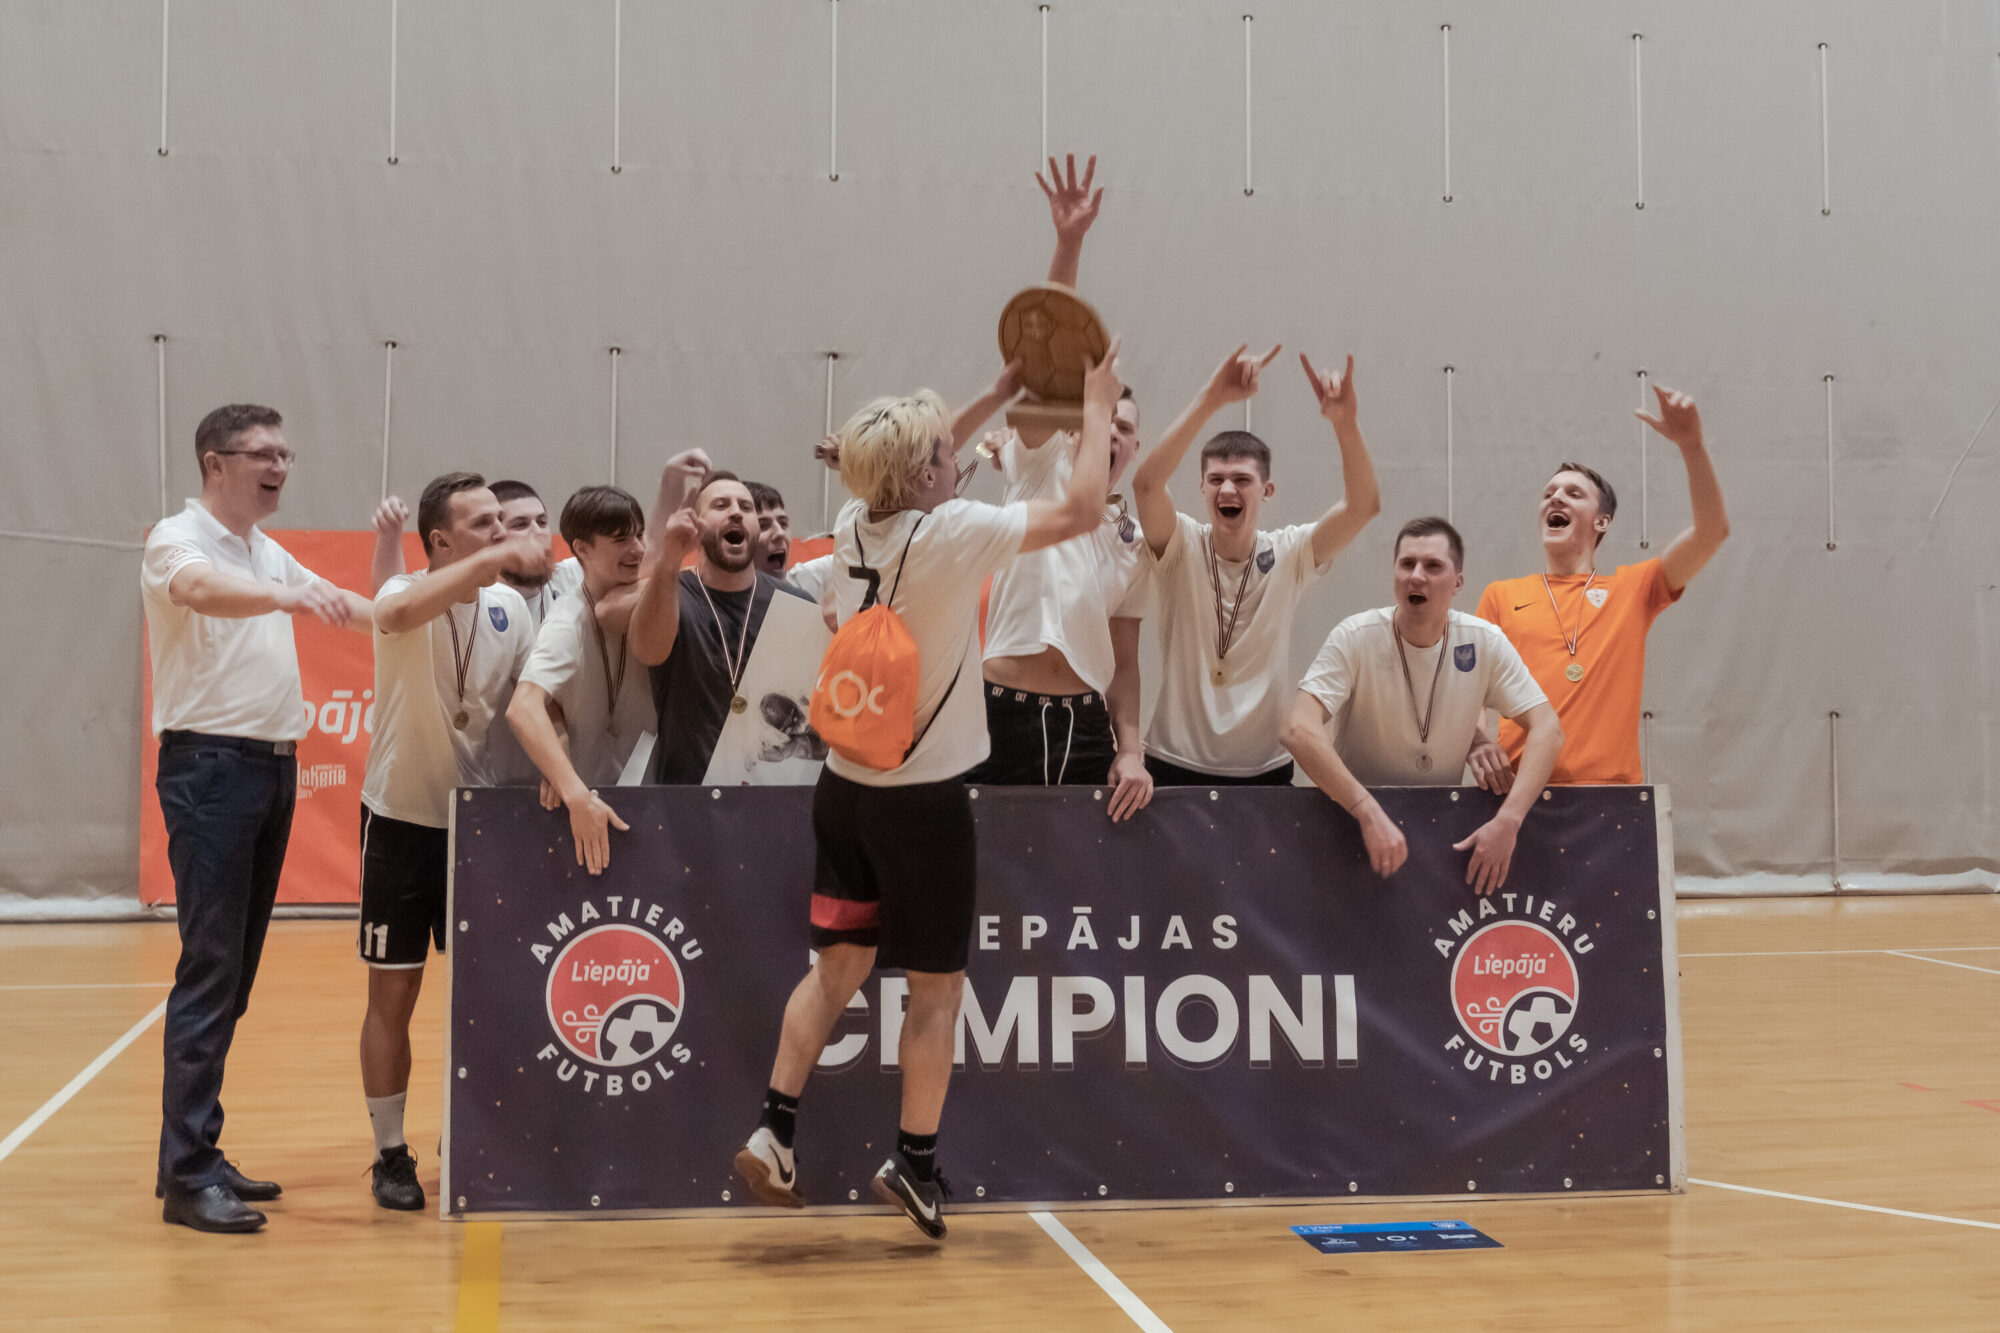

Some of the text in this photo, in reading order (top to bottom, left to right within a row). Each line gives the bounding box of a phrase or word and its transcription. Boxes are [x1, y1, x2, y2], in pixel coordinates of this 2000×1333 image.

[848, 566, 881, 614] 7
[364, 921, 389, 959] 11
[530, 896, 703, 965] AMATIERU
[979, 906, 1239, 950] EPĀJAS
[1434, 893, 1595, 958] AMATIERU
[571, 959, 651, 986] Liepāja
[1473, 953, 1547, 979] Liepāja
[536, 1043, 691, 1096] FUTBOLS
[1444, 1033, 1588, 1084] FUTBOLS
